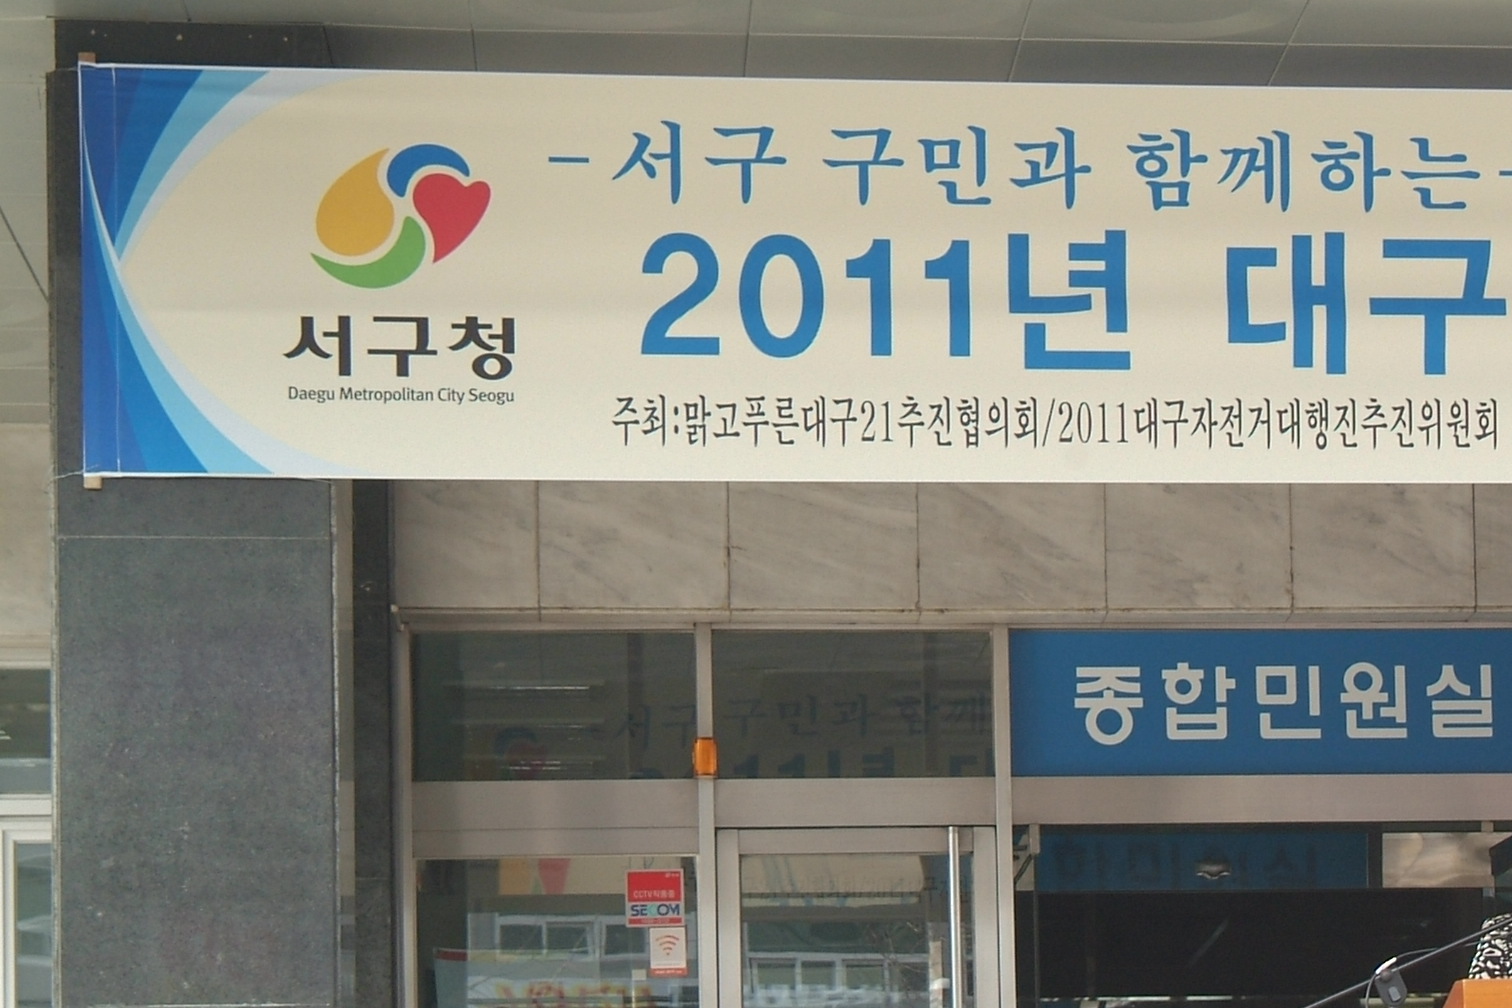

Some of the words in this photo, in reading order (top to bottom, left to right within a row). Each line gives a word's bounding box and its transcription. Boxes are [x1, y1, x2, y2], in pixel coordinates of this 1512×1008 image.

[823, 126, 1092, 210] 구민과
[641, 230, 1131, 371] 2011년
[283, 315, 516, 380] 서구청
[288, 386, 335, 404] Daegu
[339, 387, 434, 404] Metropolitan
[437, 388, 465, 405] City
[468, 388, 515, 405] Seogu
[1074, 662, 1494, 746] 종합민원실
[630, 903, 680, 917] SECOM
